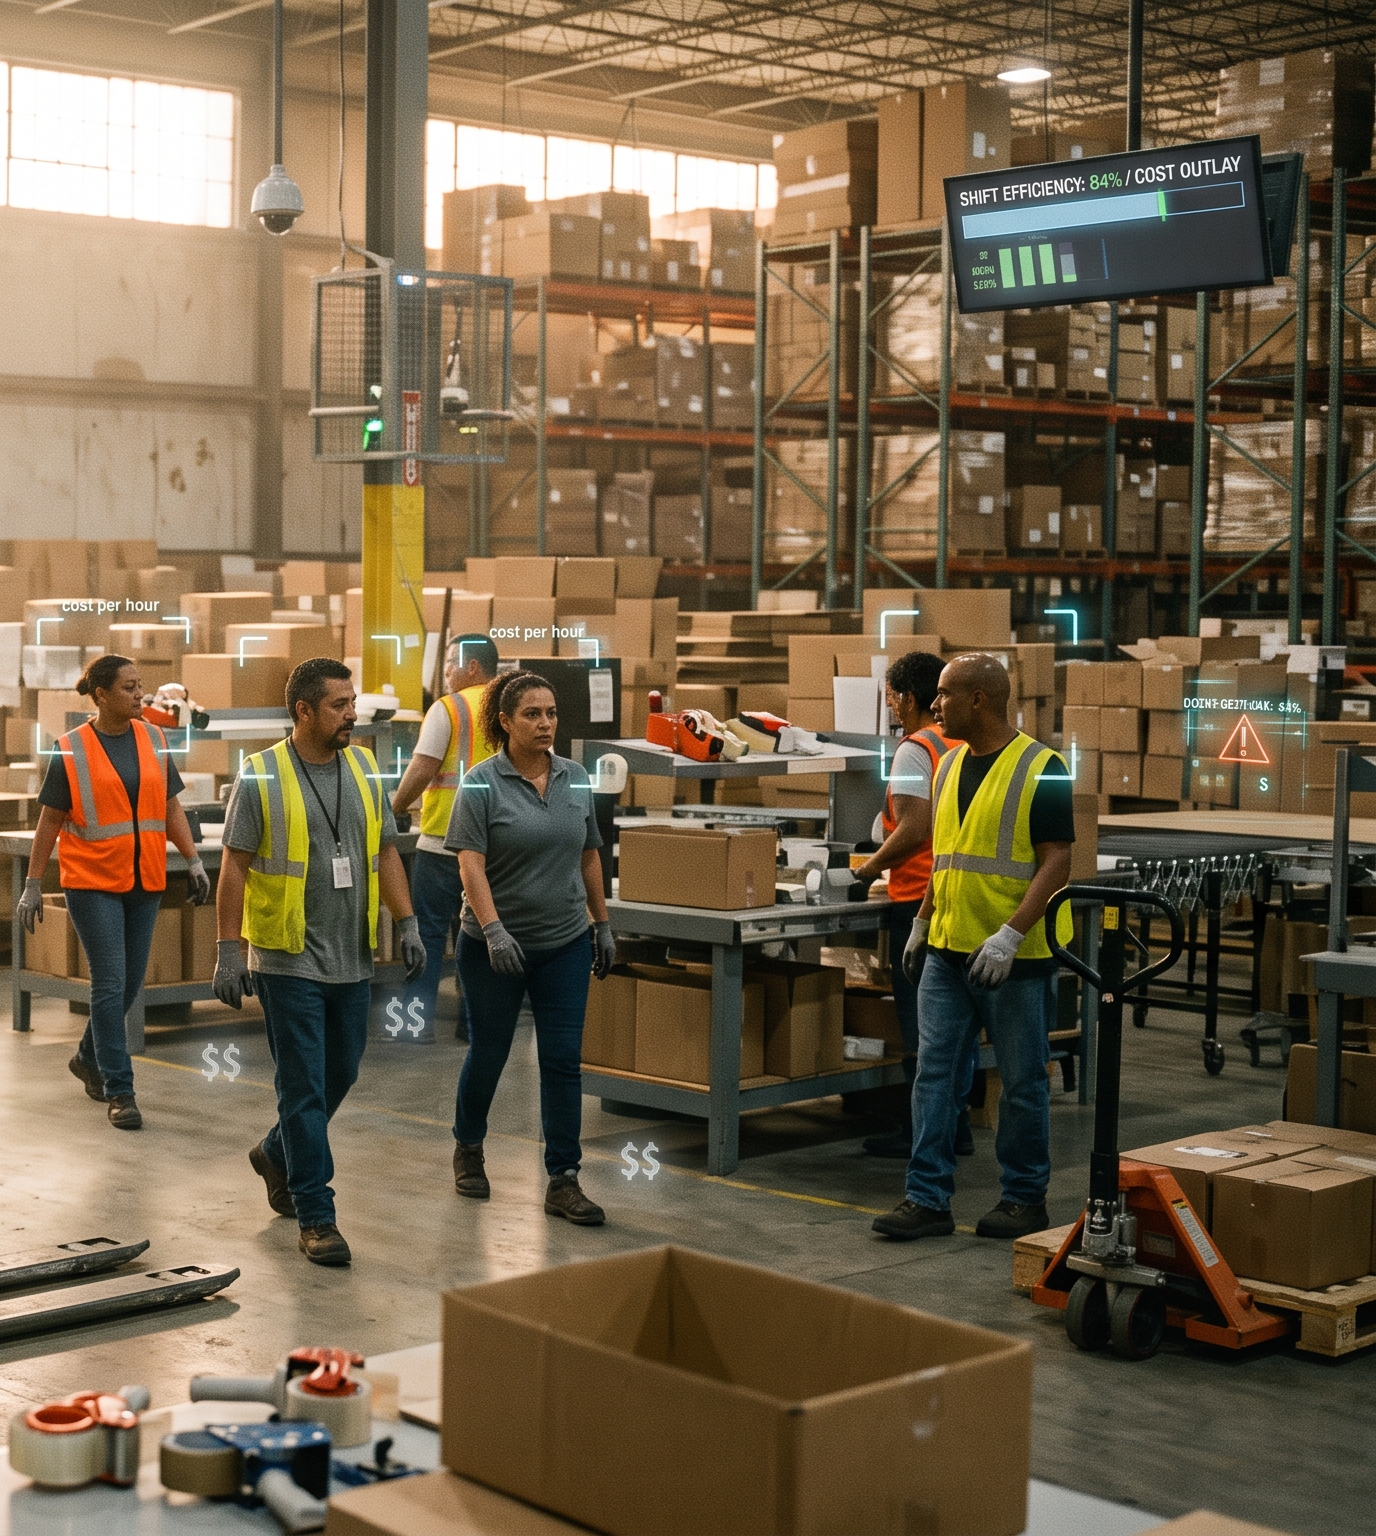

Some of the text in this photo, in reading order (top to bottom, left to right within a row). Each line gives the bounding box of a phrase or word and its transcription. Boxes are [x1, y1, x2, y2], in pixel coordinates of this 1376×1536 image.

[960, 156, 1241, 207] SHIFT EFFICIENCY: 84% / COST OUTLAY
